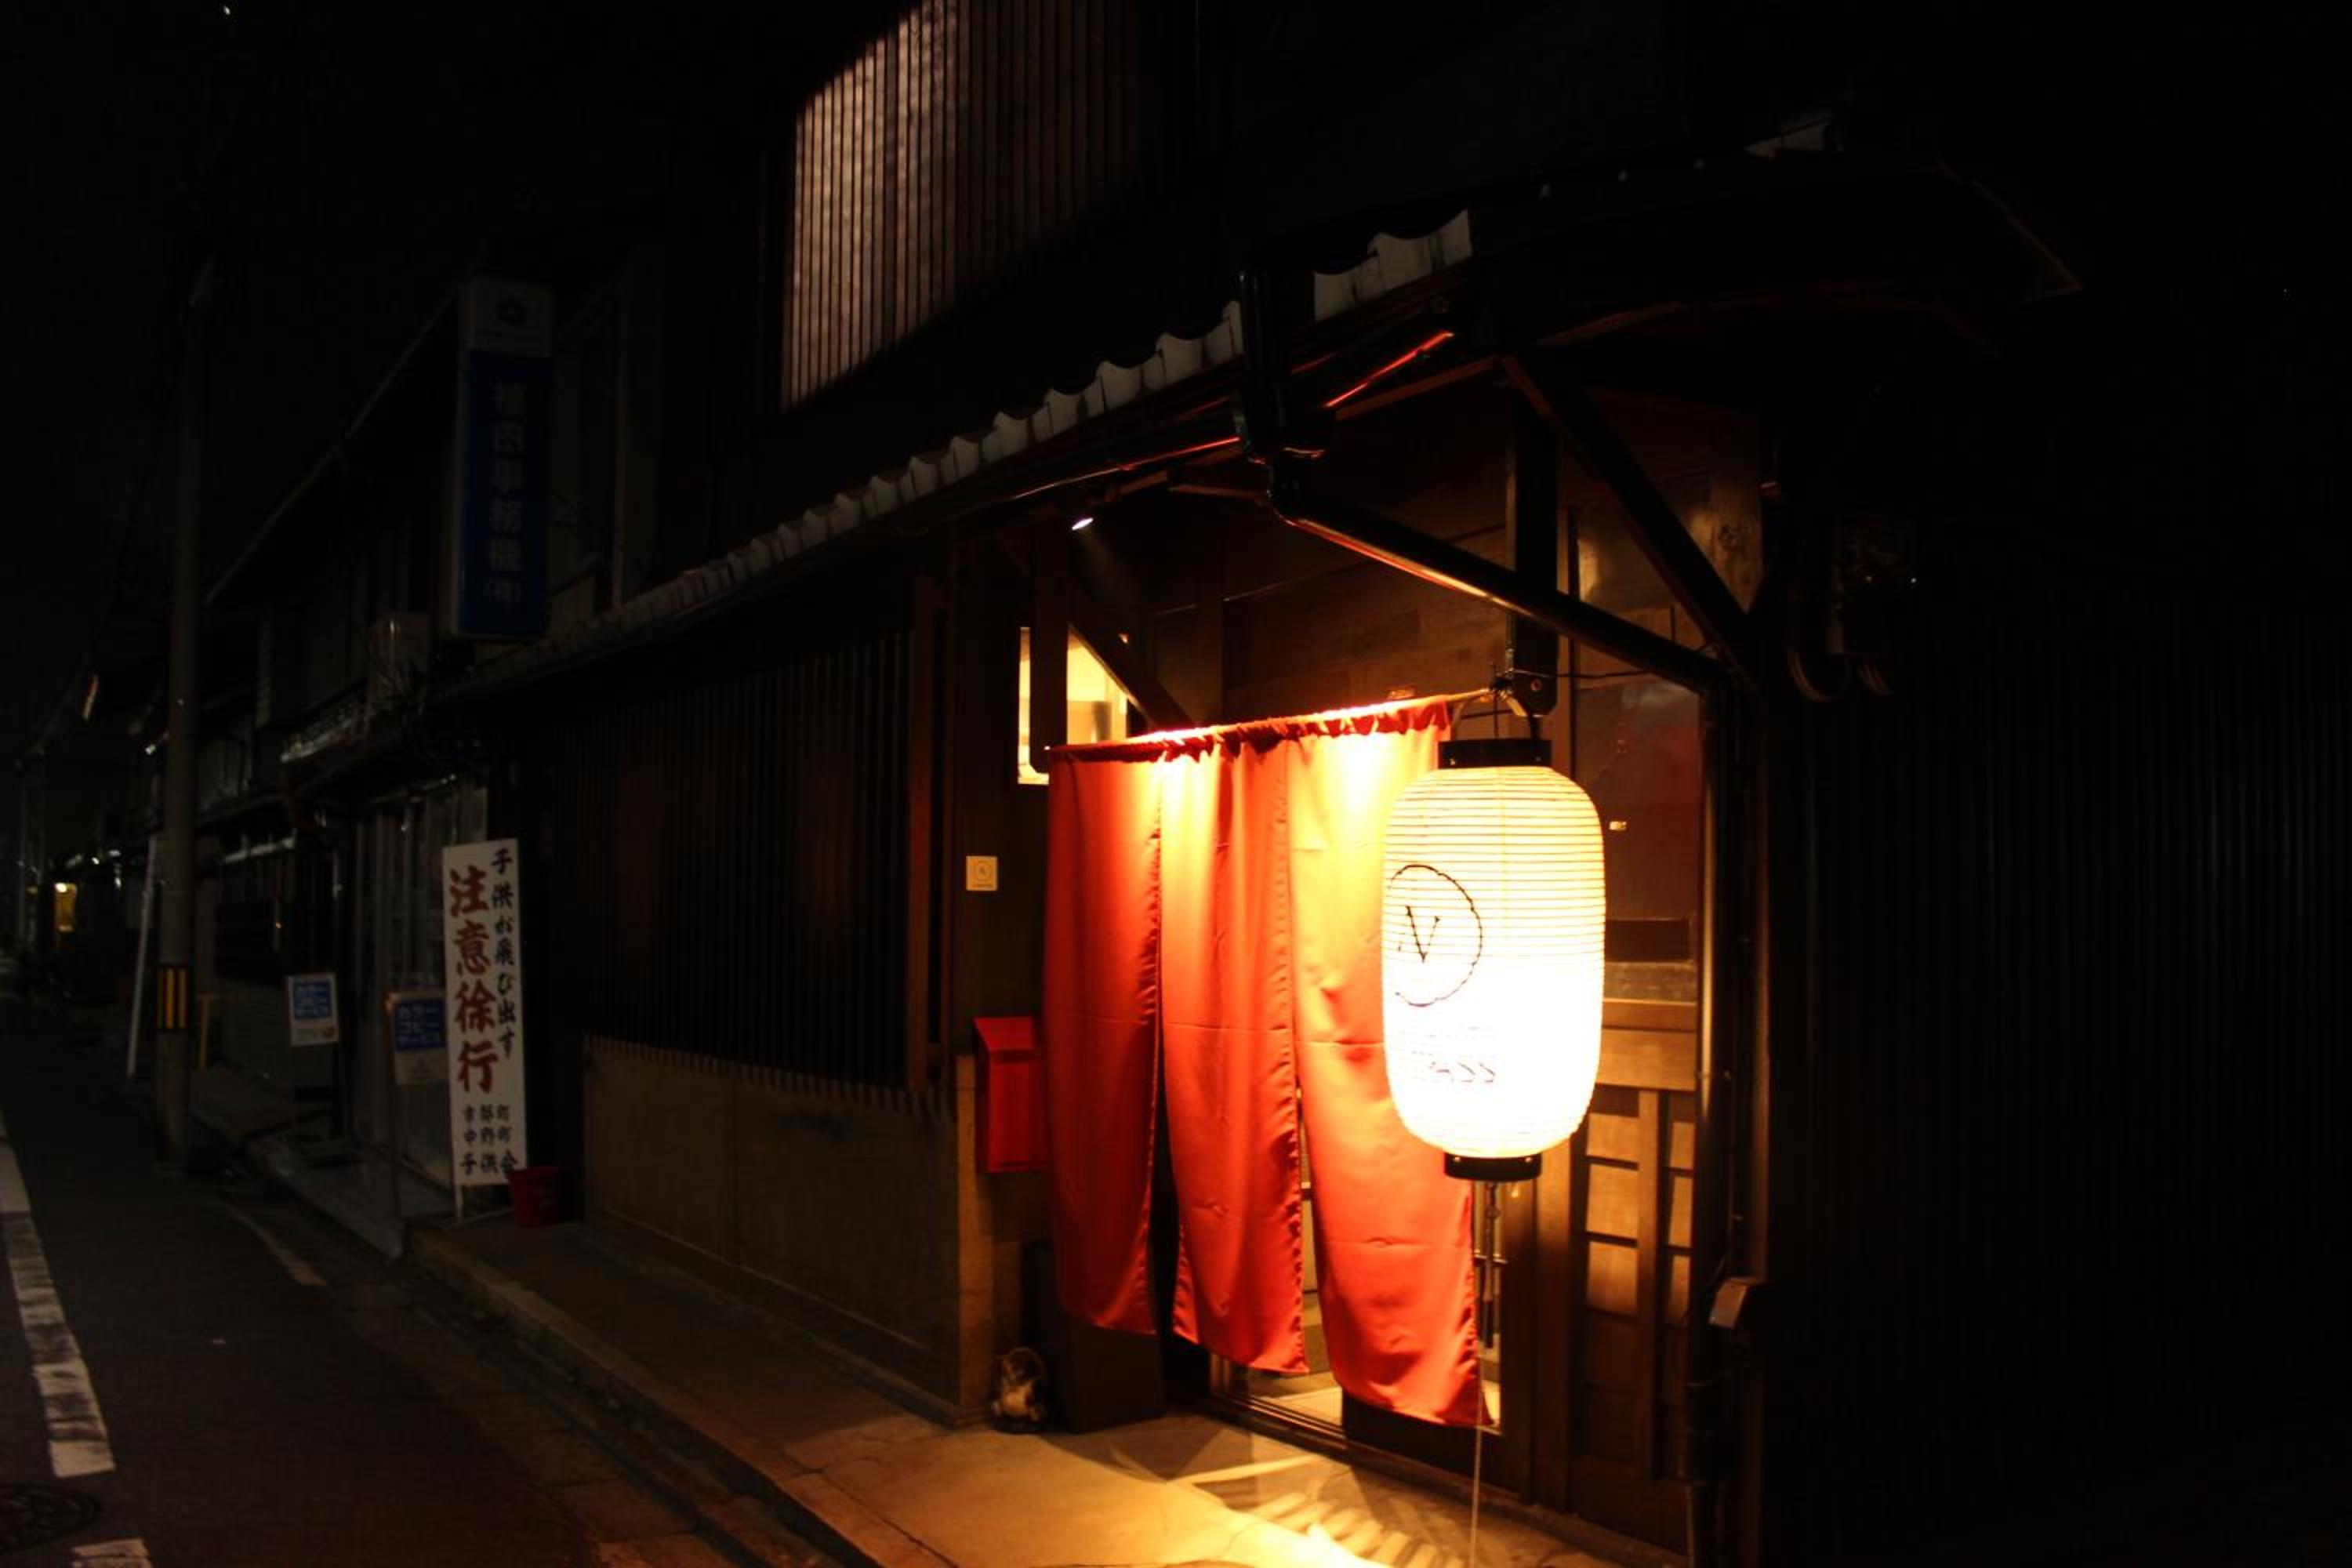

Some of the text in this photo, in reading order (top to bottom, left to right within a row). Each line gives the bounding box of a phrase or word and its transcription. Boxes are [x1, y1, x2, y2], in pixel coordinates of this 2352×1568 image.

[450, 865, 499, 1093] 注意徐行
[491, 848, 516, 1058] 子供が飛び出す
